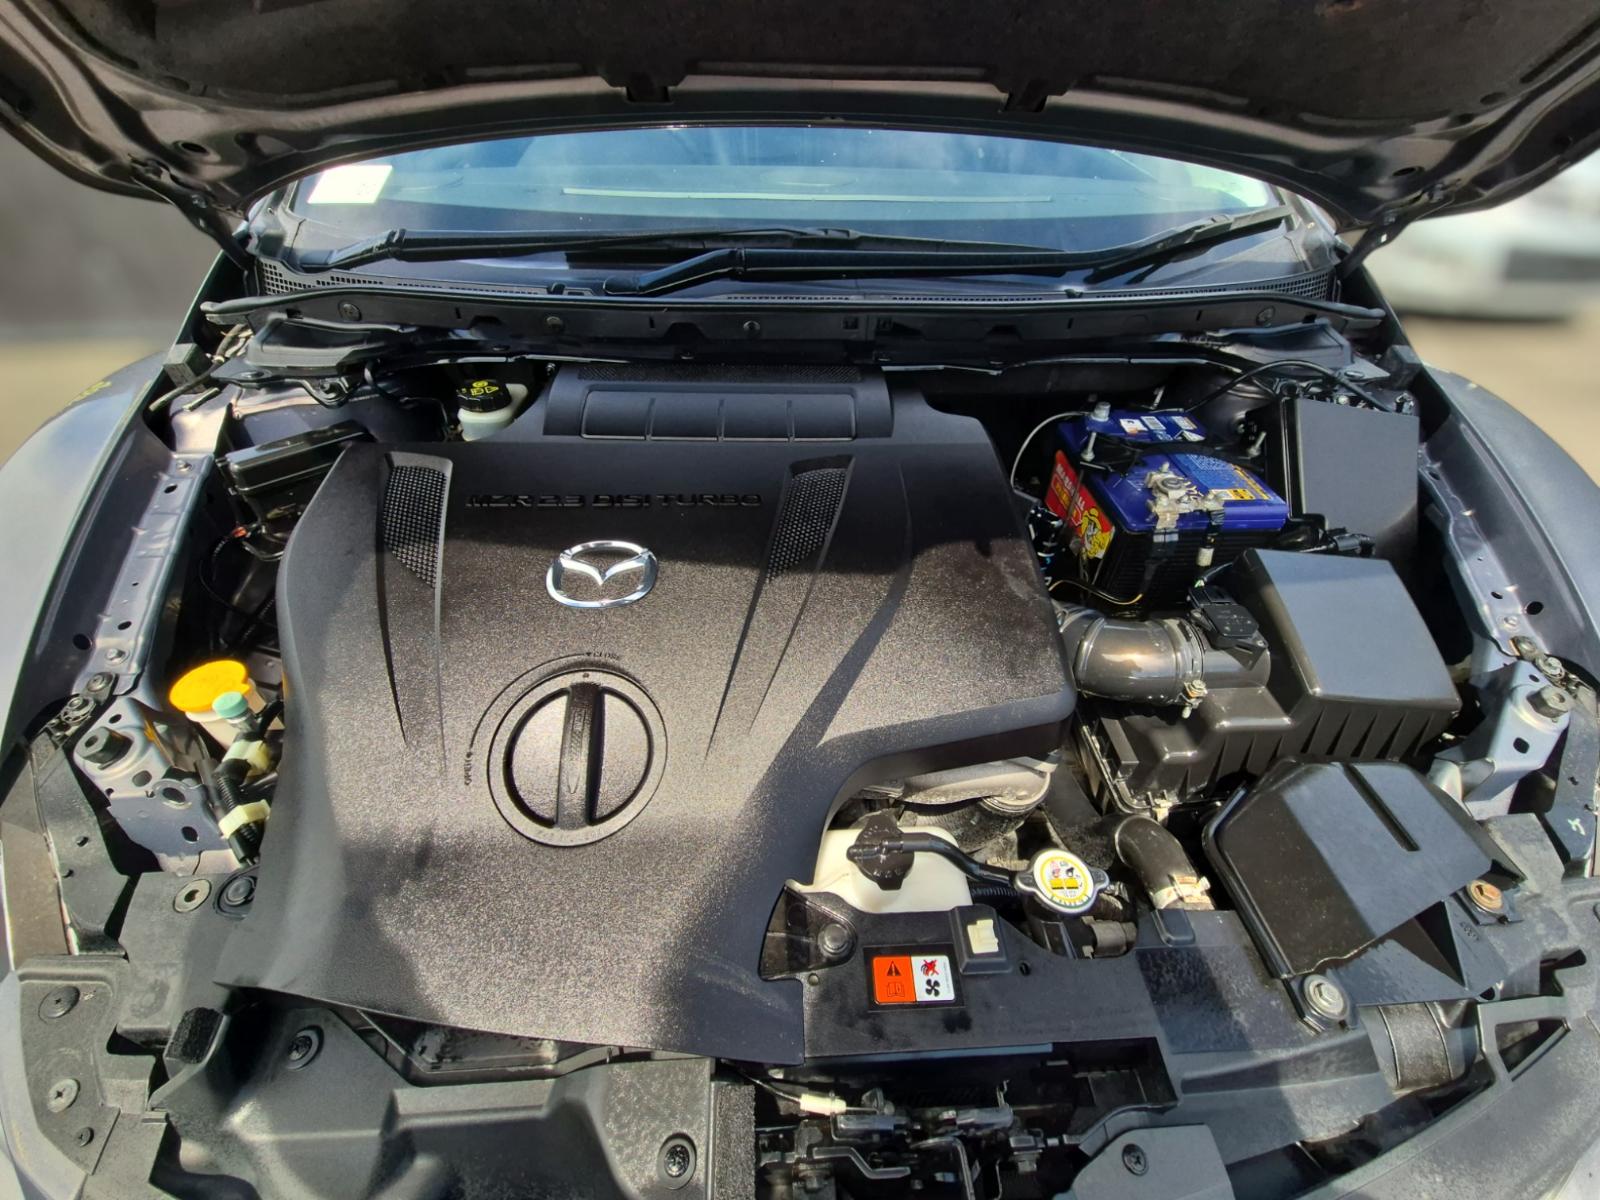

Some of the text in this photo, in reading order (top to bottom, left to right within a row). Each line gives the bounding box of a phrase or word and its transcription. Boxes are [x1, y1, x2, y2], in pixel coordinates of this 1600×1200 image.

[537, 494, 585, 507] 2.3
[592, 494, 650, 507] DISI
[656, 494, 762, 507] TURBO
